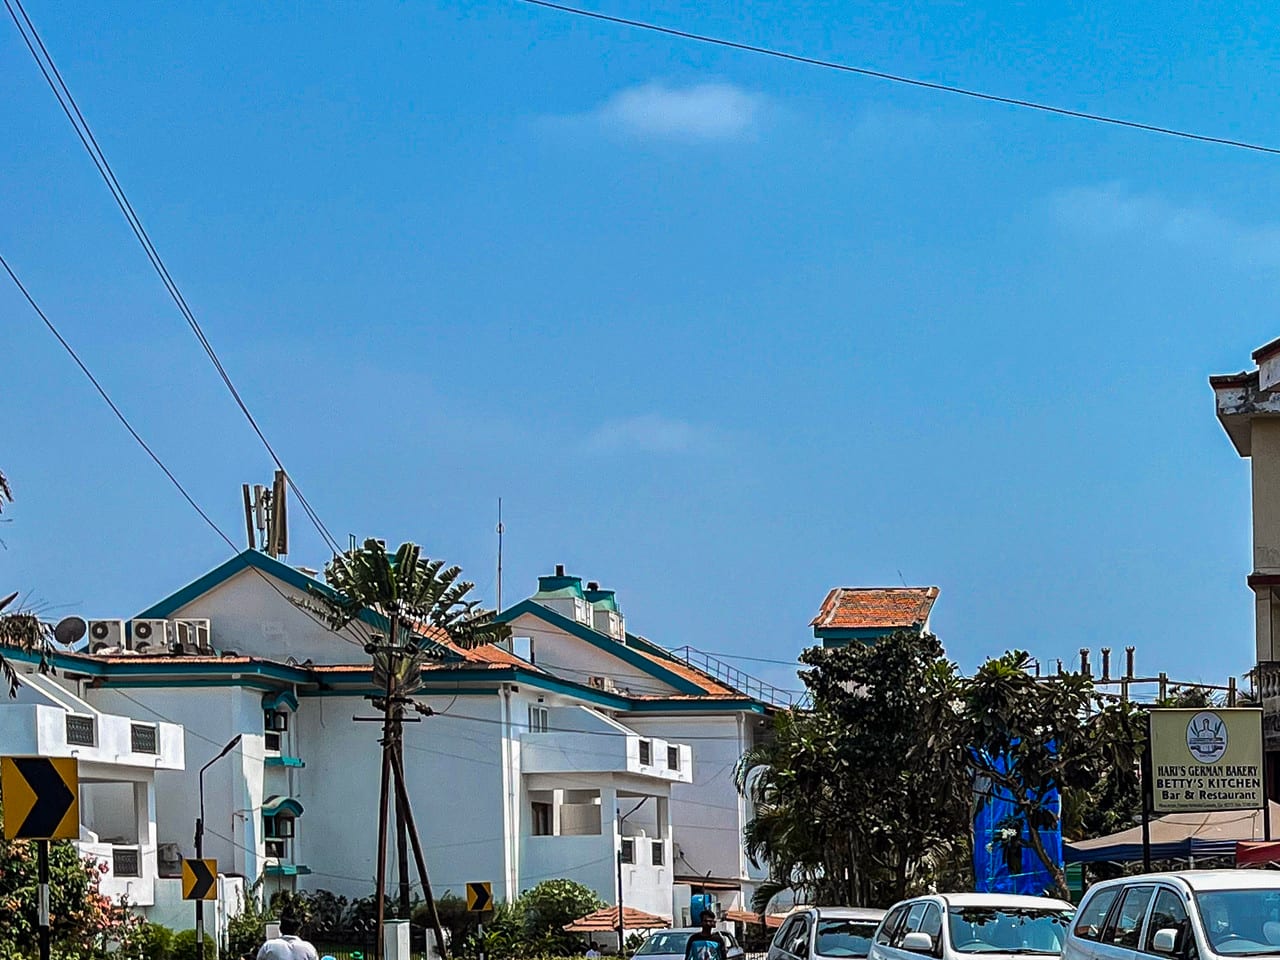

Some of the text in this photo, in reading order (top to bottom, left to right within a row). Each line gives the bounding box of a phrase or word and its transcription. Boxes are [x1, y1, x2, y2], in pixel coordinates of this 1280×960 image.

[1157, 765, 1259, 777] HARI'S GERMAN BAKERY
[1156, 778, 1261, 789] BETTY'S KITCHEN
[1162, 789, 1257, 800] Bar & Restaurant
